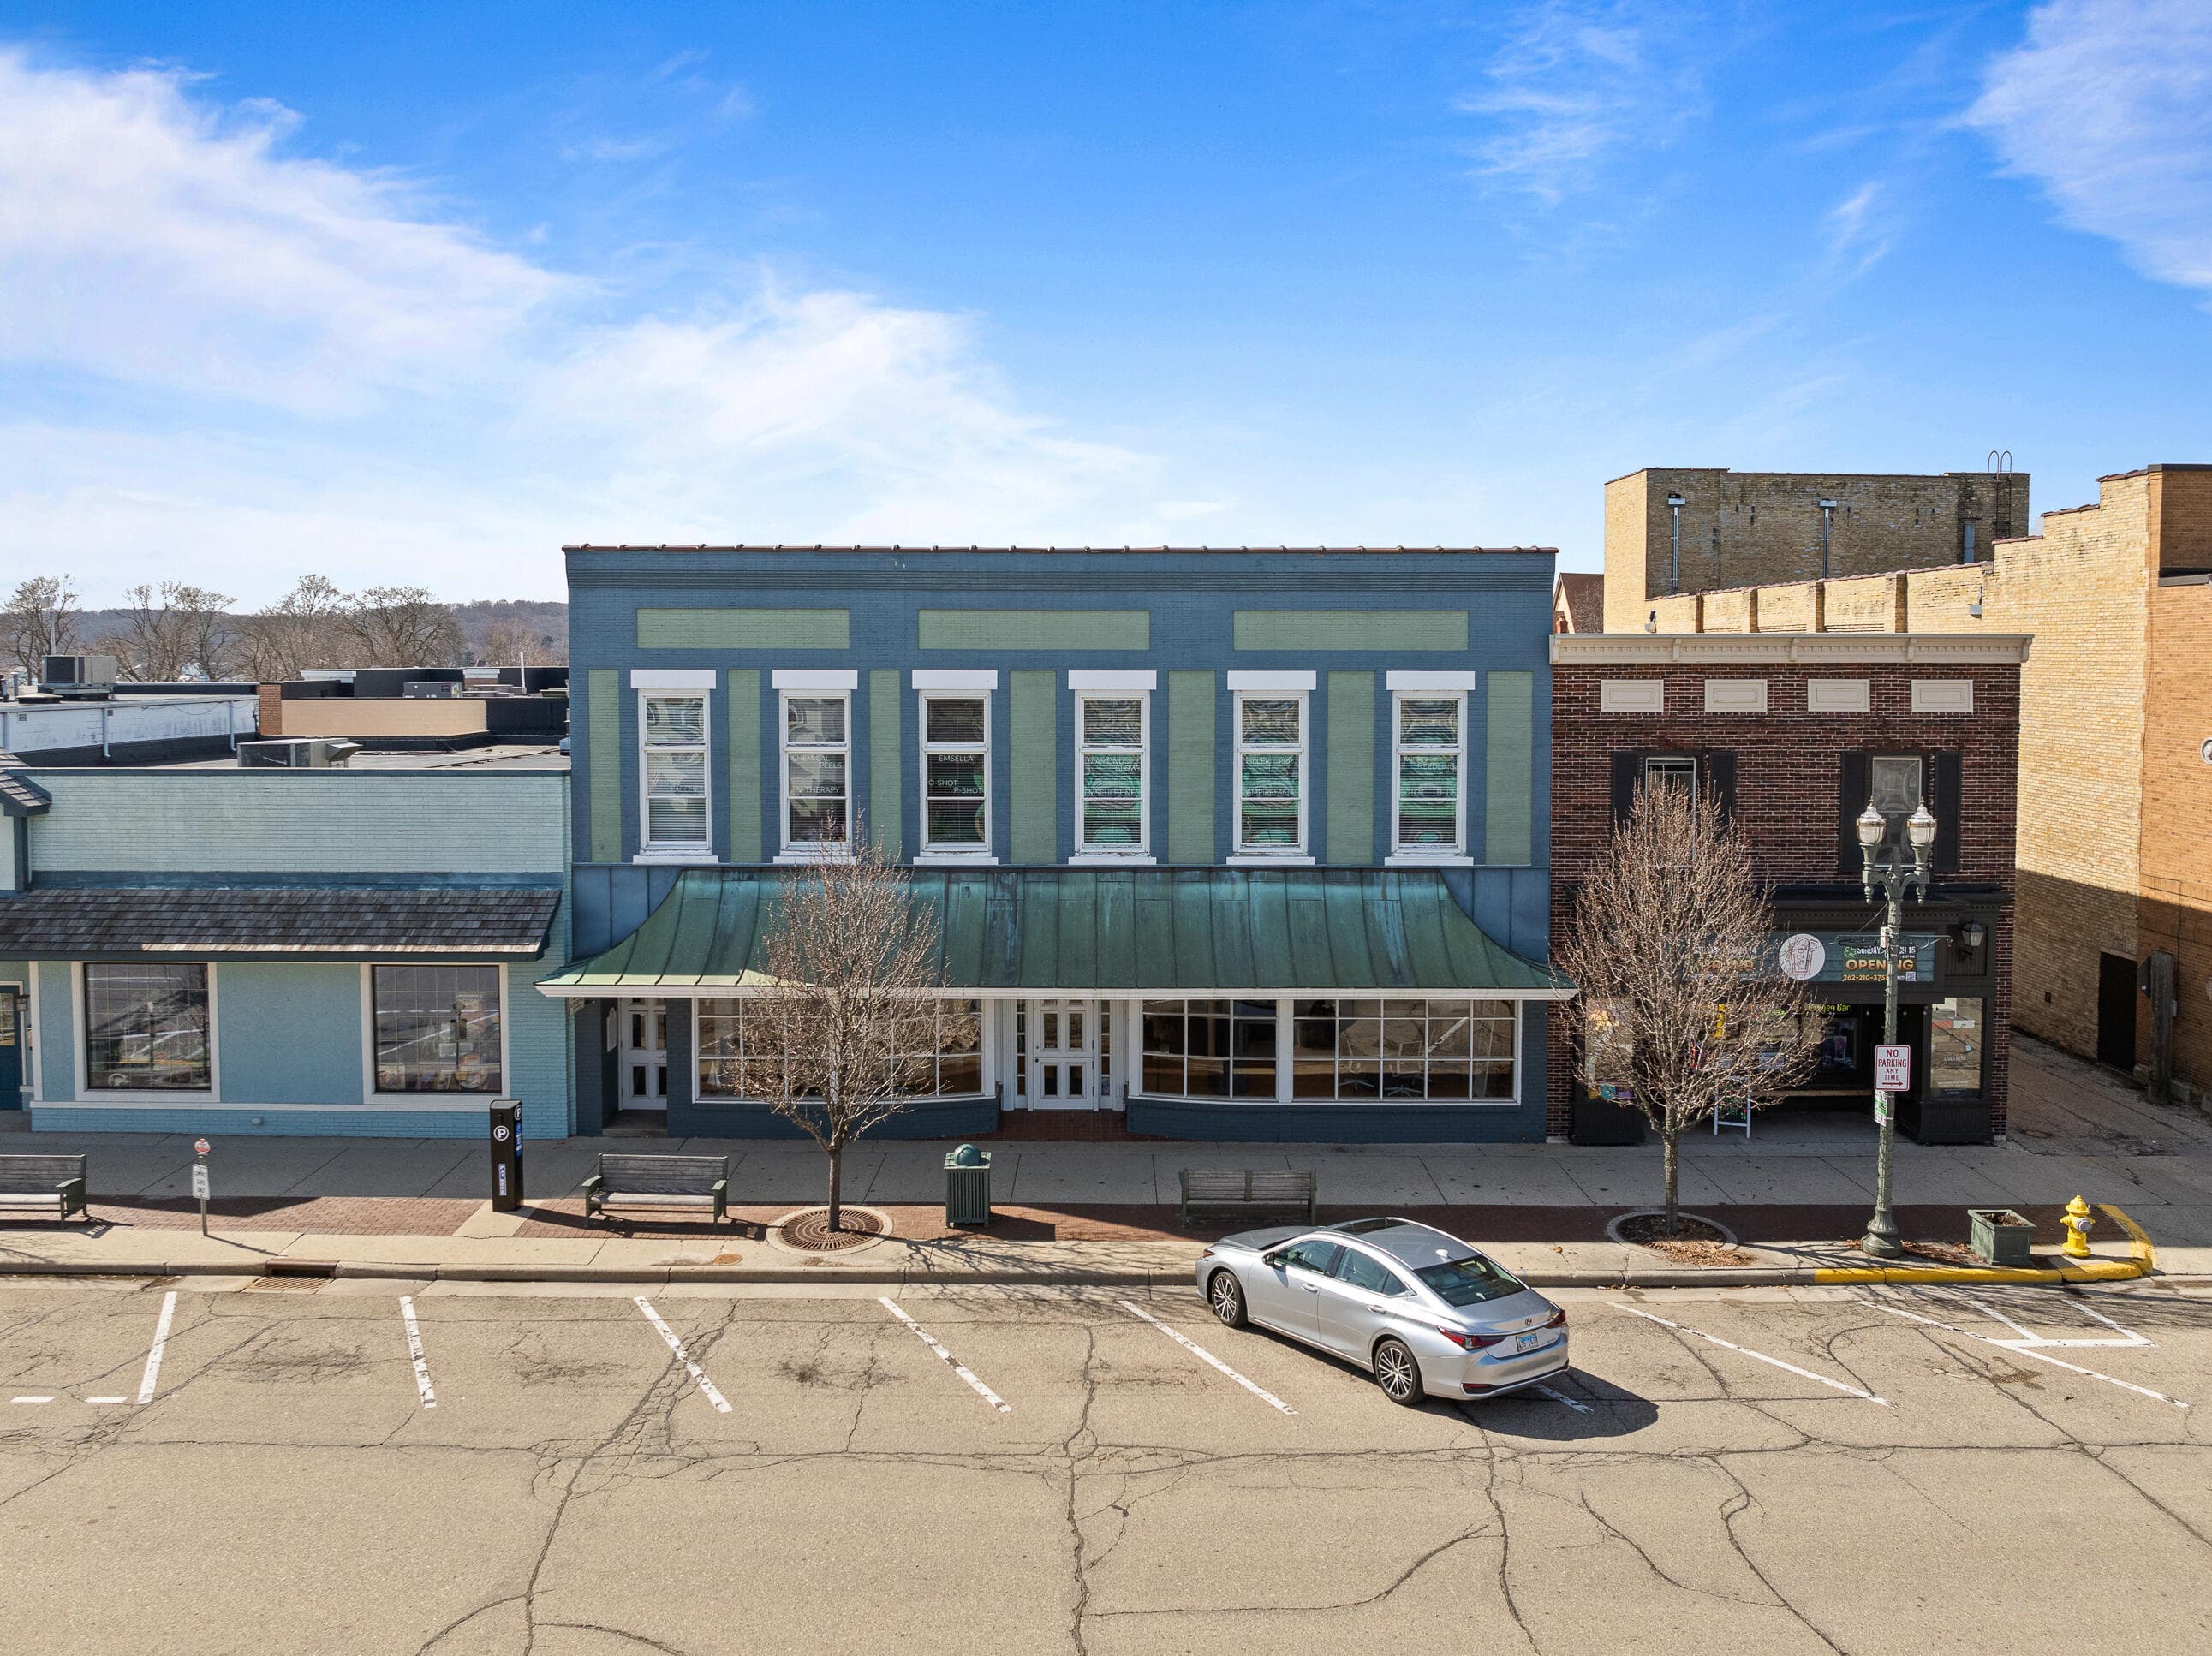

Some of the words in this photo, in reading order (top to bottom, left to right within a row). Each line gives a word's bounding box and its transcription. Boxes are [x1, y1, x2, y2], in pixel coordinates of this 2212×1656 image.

[1845, 959, 1914, 971] OPENG
[1887, 1049, 1899, 1057] NO
[1878, 1058, 1906, 1068] PARKING
[498, 1128, 507, 1139] P
